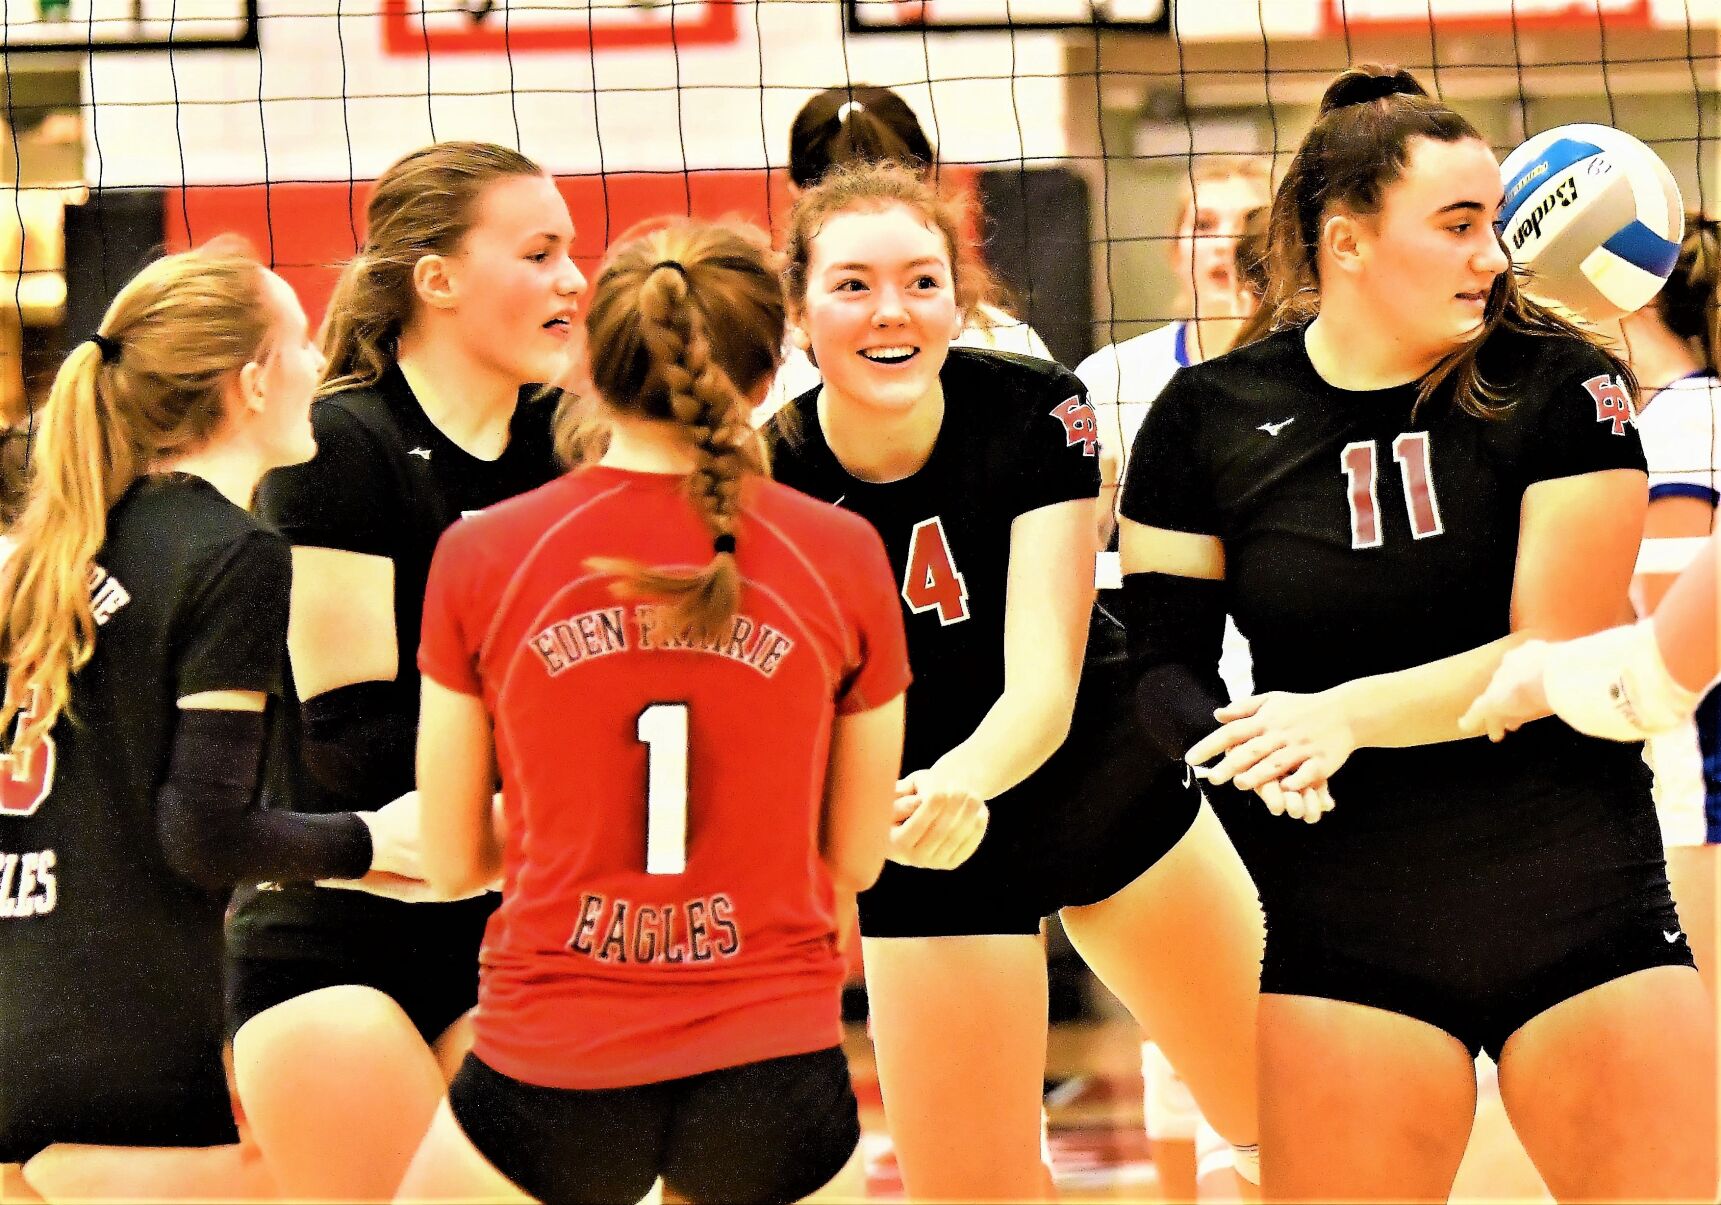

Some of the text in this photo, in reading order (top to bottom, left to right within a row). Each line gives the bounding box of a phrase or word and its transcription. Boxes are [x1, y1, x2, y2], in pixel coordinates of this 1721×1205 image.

[1512, 176, 1578, 250] Baden
[1341, 431, 1444, 550] 11
[88, 566, 132, 626] IE
[901, 515, 970, 627] 4
[528, 605, 795, 678] EDEN PRIE
[637, 701, 689, 875] 1
[566, 893, 741, 965] EAGLES
